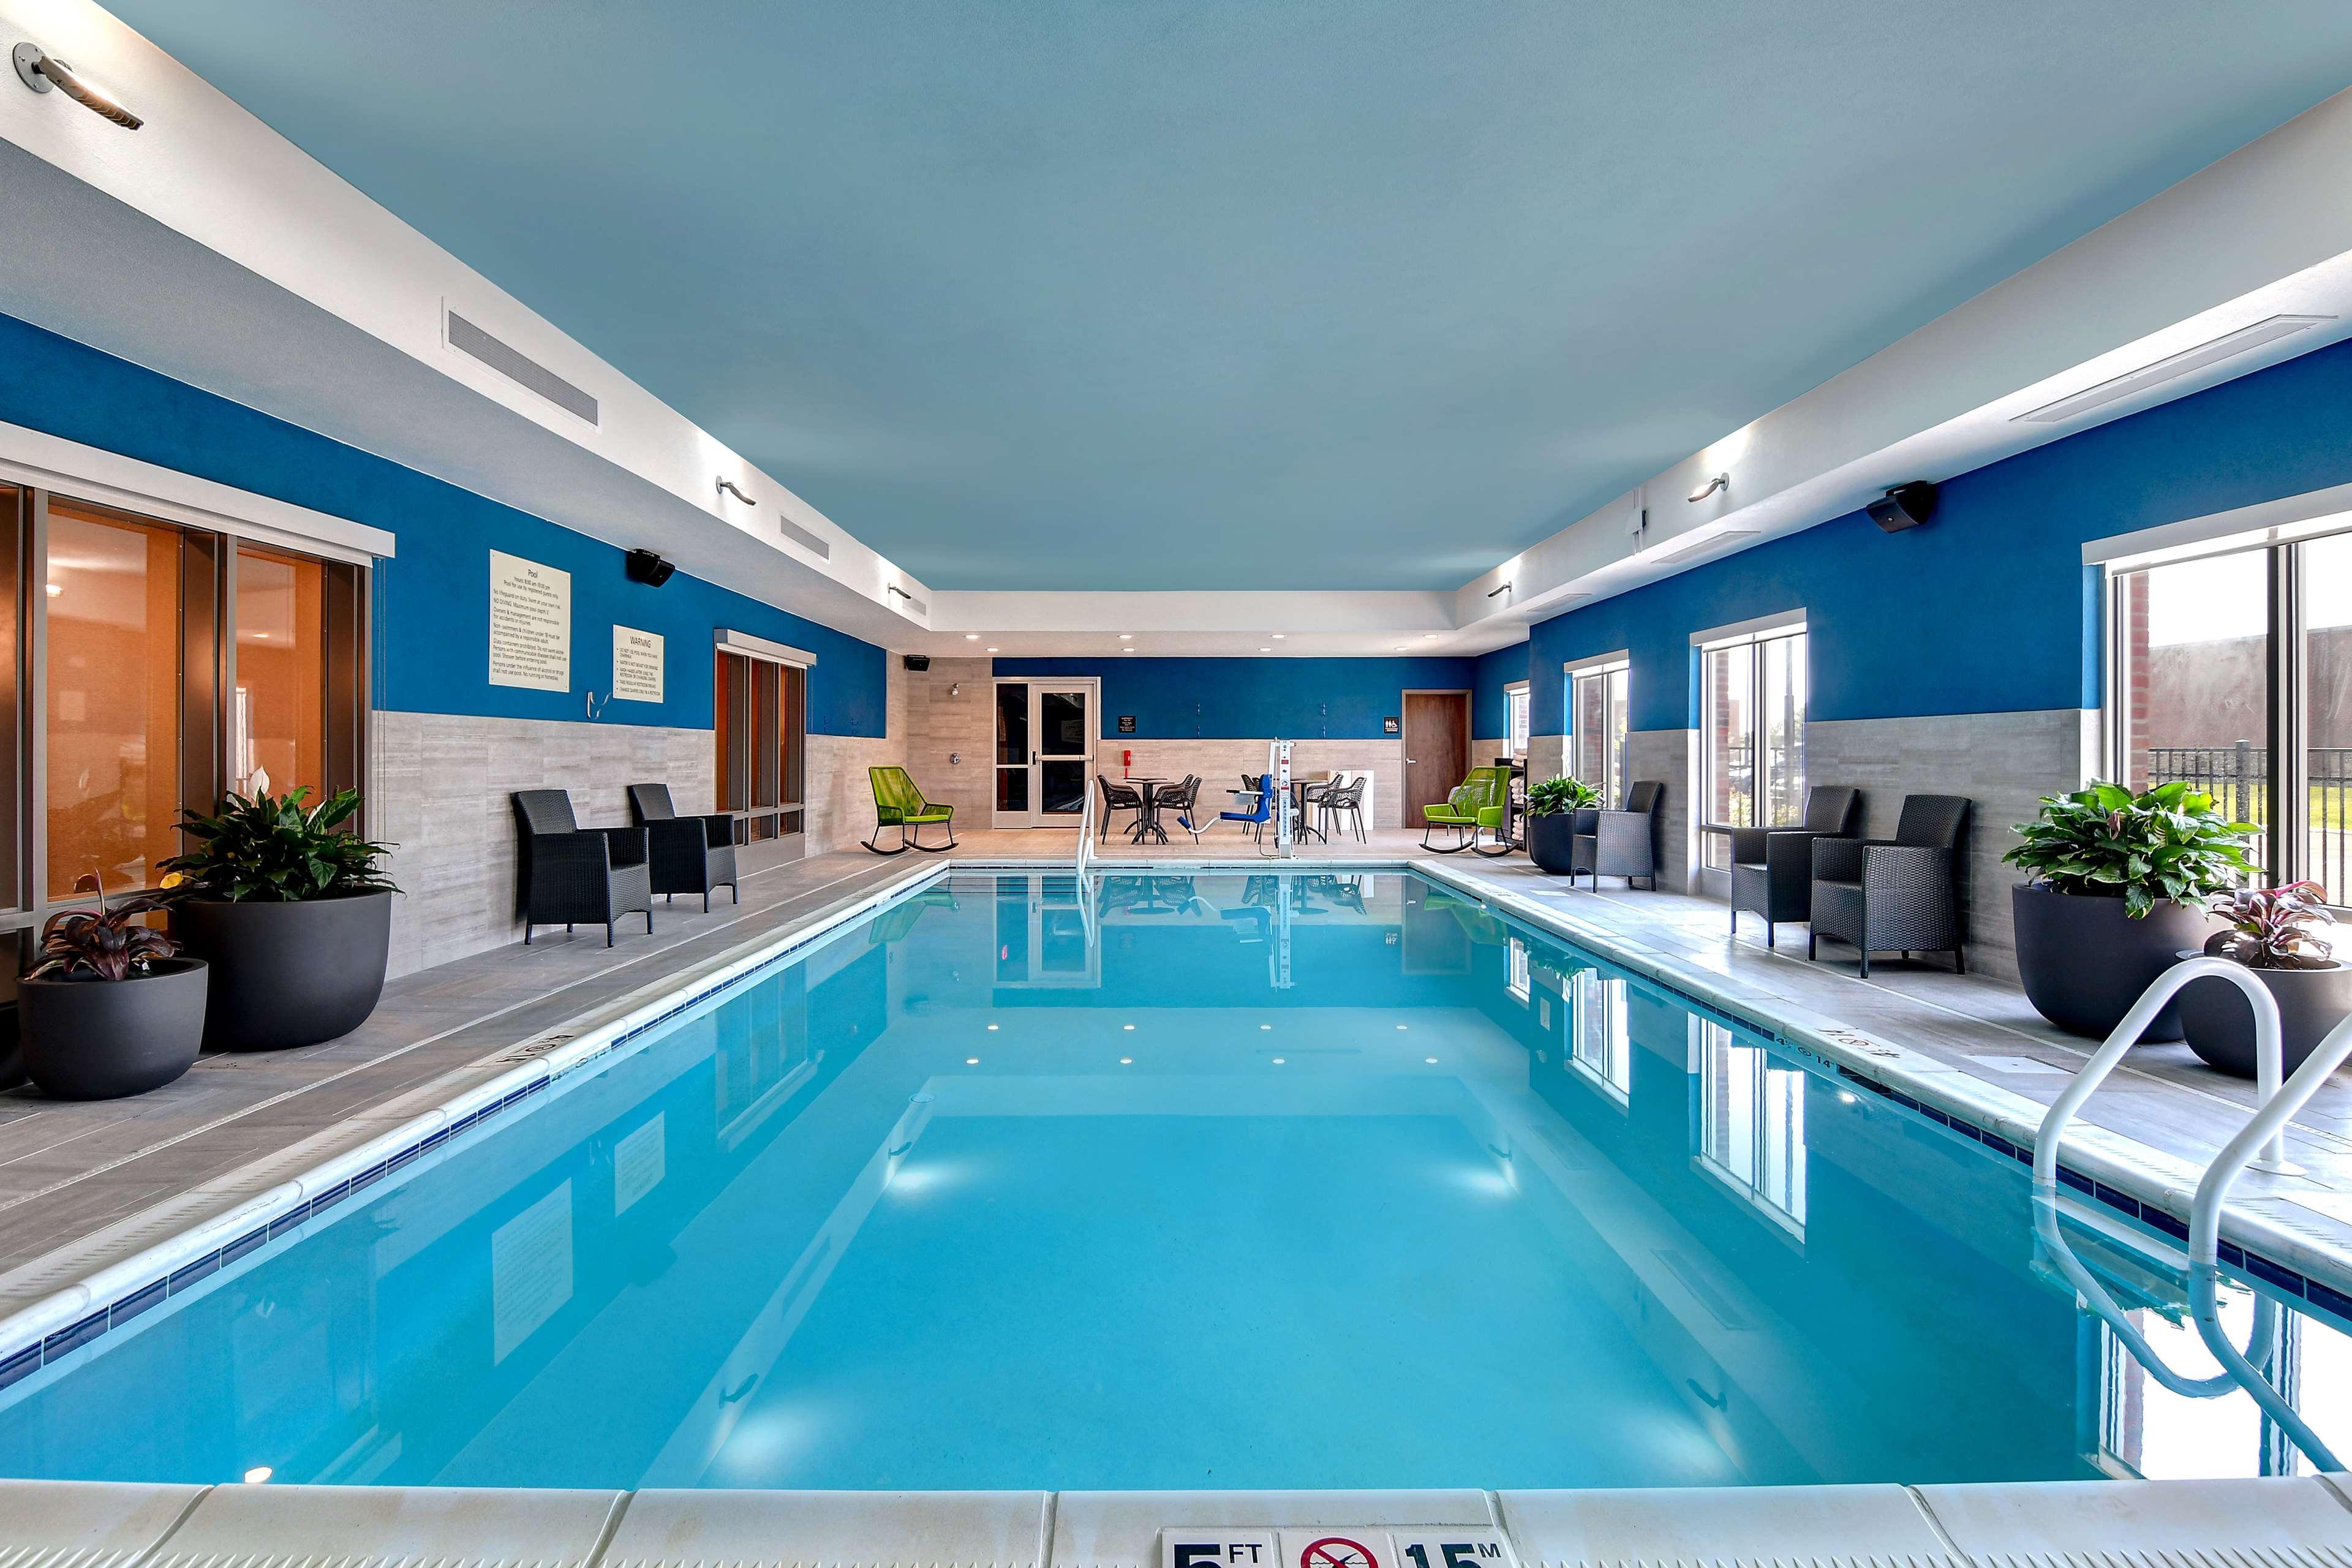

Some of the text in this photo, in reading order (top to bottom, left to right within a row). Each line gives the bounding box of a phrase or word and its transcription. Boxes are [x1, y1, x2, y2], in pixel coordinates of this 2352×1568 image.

[528, 569, 538, 578] Pool
[499, 589, 514, 598] lifeguard
[510, 611, 531, 619] management
[630, 636, 651, 648] WARNING
